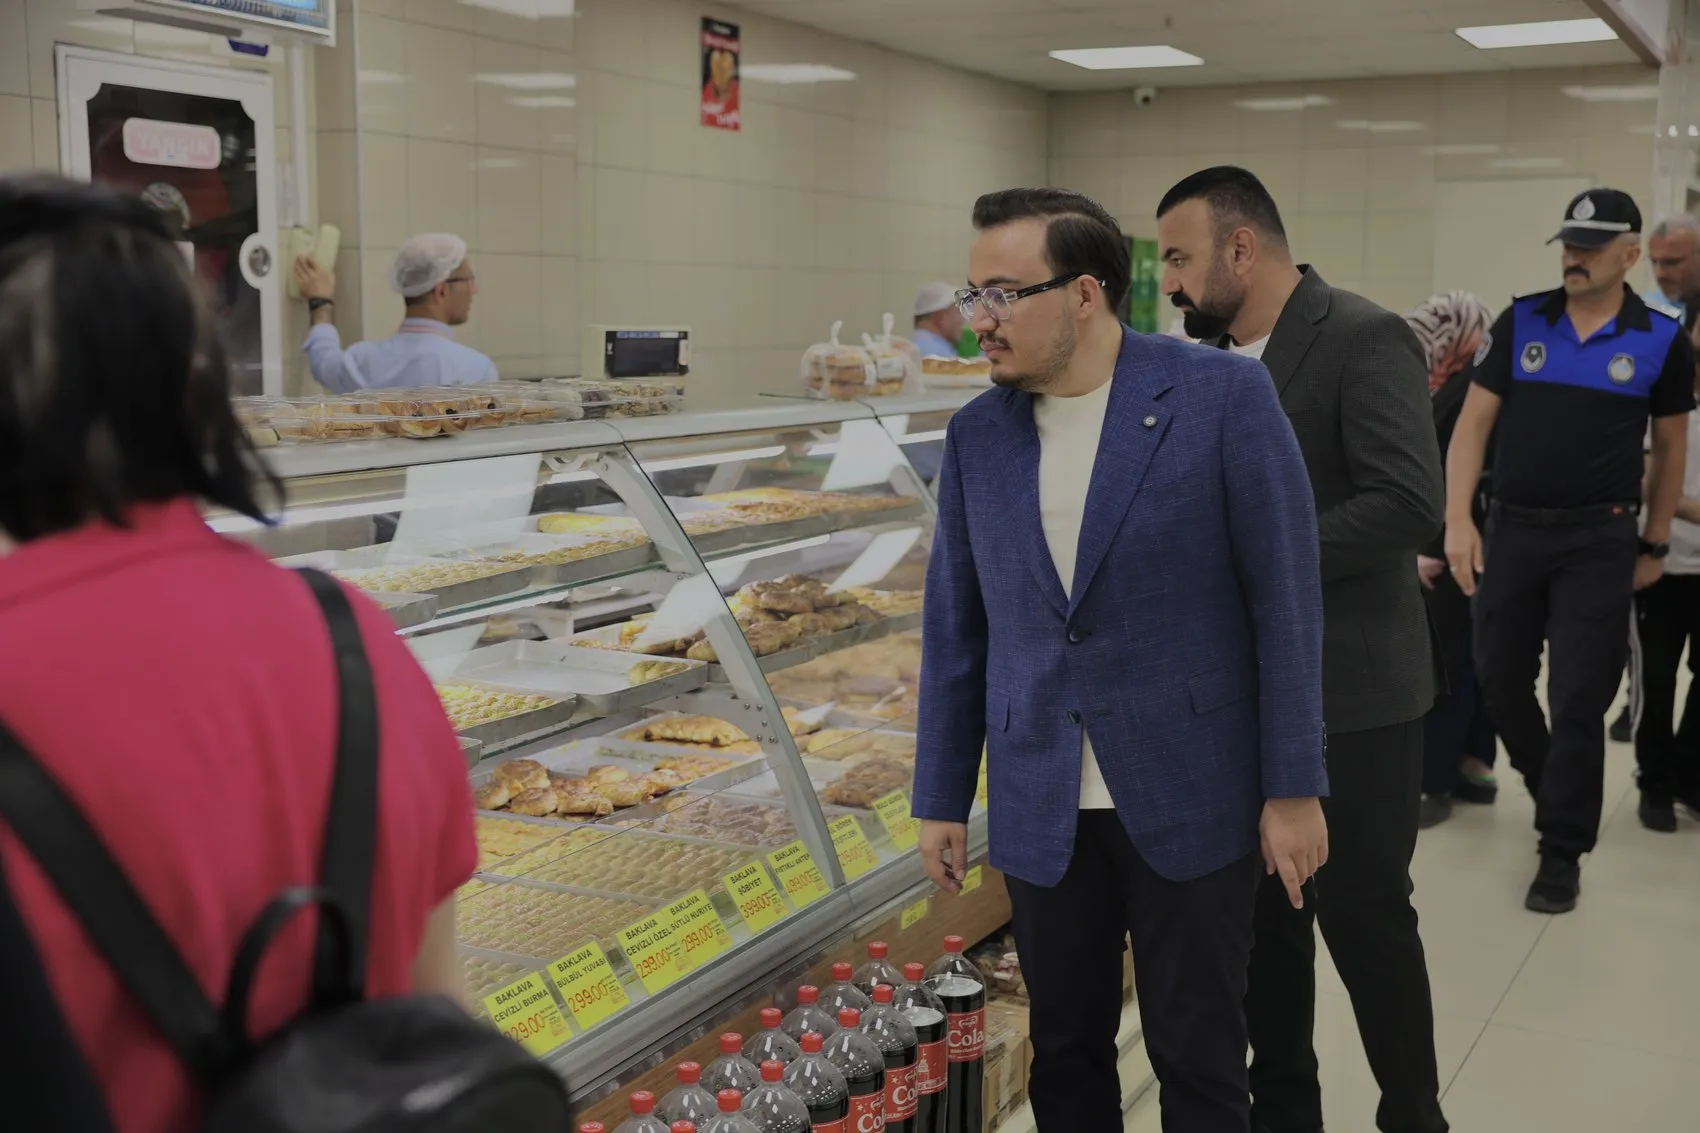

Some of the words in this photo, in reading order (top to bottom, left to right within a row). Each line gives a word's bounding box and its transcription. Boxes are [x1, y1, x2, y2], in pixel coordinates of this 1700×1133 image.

[774, 846, 800, 862] BAKLAVA
[730, 866, 757, 884] BAKLAVA
[670, 895, 700, 916] BAKLAVA
[625, 919, 658, 940] BAKLAVA
[626, 937, 653, 956] CEVİZLİ
[653, 927, 672, 942] ÖZEL
[557, 949, 593, 972] BAKLAVA
[495, 980, 534, 1005] BAKLAVA
[494, 1001, 523, 1022] CEVİZLİ
[523, 988, 550, 1008] BURMA
[948, 1028, 984, 1047] Cola
[857, 1107, 886, 1133] Col
